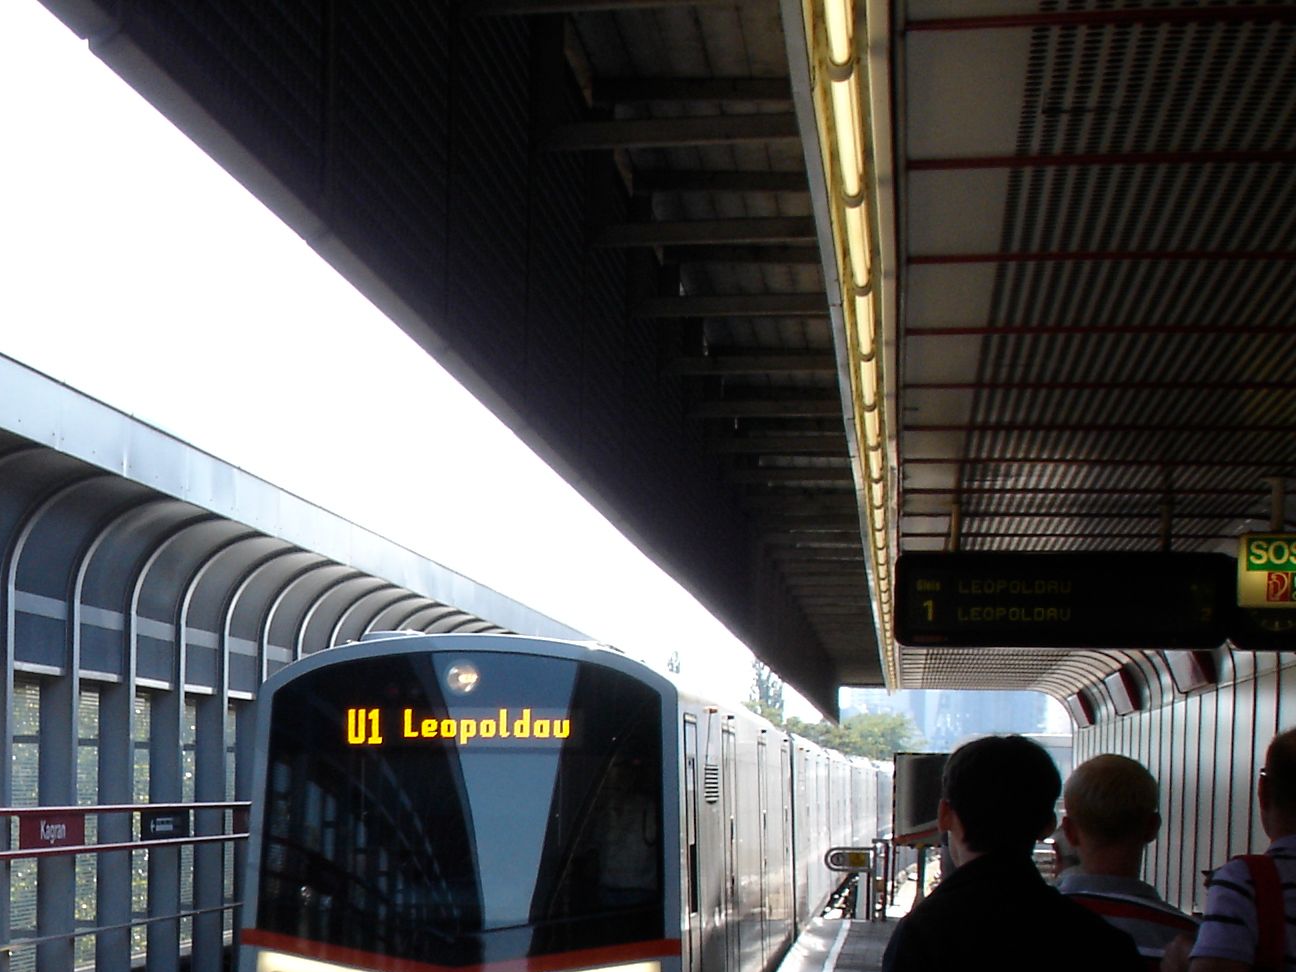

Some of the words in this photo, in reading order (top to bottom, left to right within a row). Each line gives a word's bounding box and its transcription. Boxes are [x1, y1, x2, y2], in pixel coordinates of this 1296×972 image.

[958, 578, 1073, 594] LEOPOLDAU
[922, 599, 934, 621] 1
[957, 606, 1073, 622] LEOPOLDAU
[347, 708, 383, 745] U1
[403, 708, 571, 745] Leopoldau
[40, 819, 66, 844] Kagran
